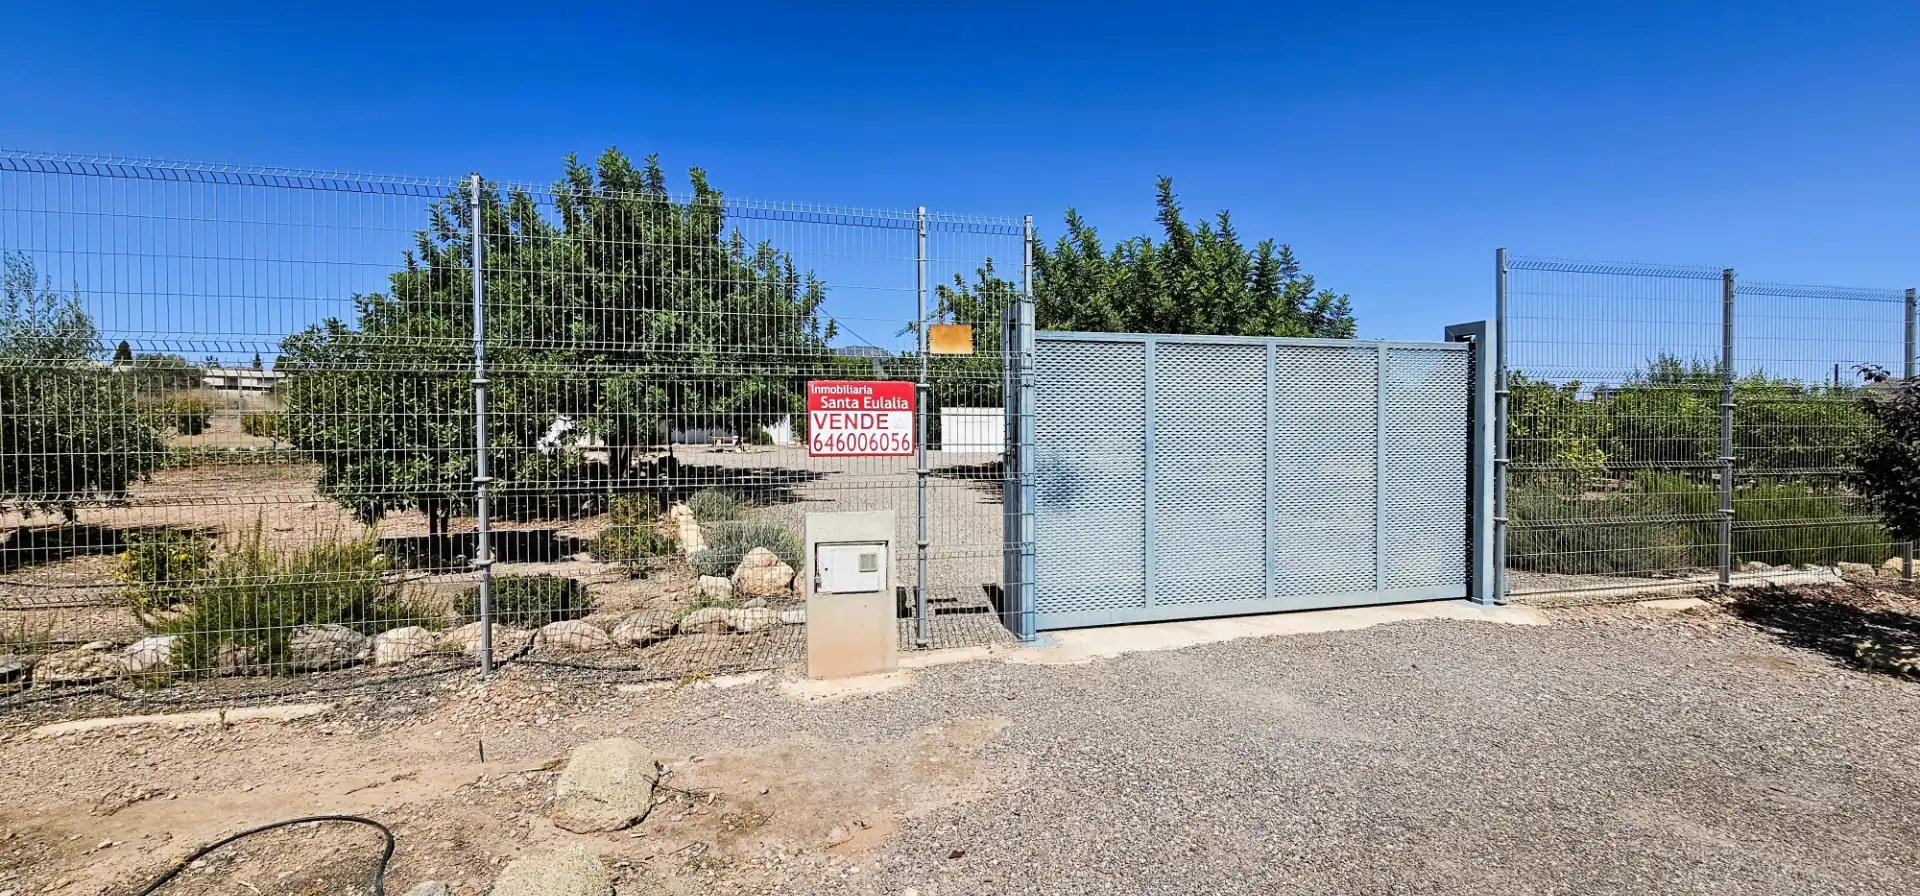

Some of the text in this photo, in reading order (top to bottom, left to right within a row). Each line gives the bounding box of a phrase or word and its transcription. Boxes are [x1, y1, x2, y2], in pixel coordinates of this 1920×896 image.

[811, 385, 872, 394] Inmobiliaria
[821, 396, 908, 409] Santa Eulalia
[814, 413, 889, 429] VENDE
[814, 433, 910, 451] 646006056
